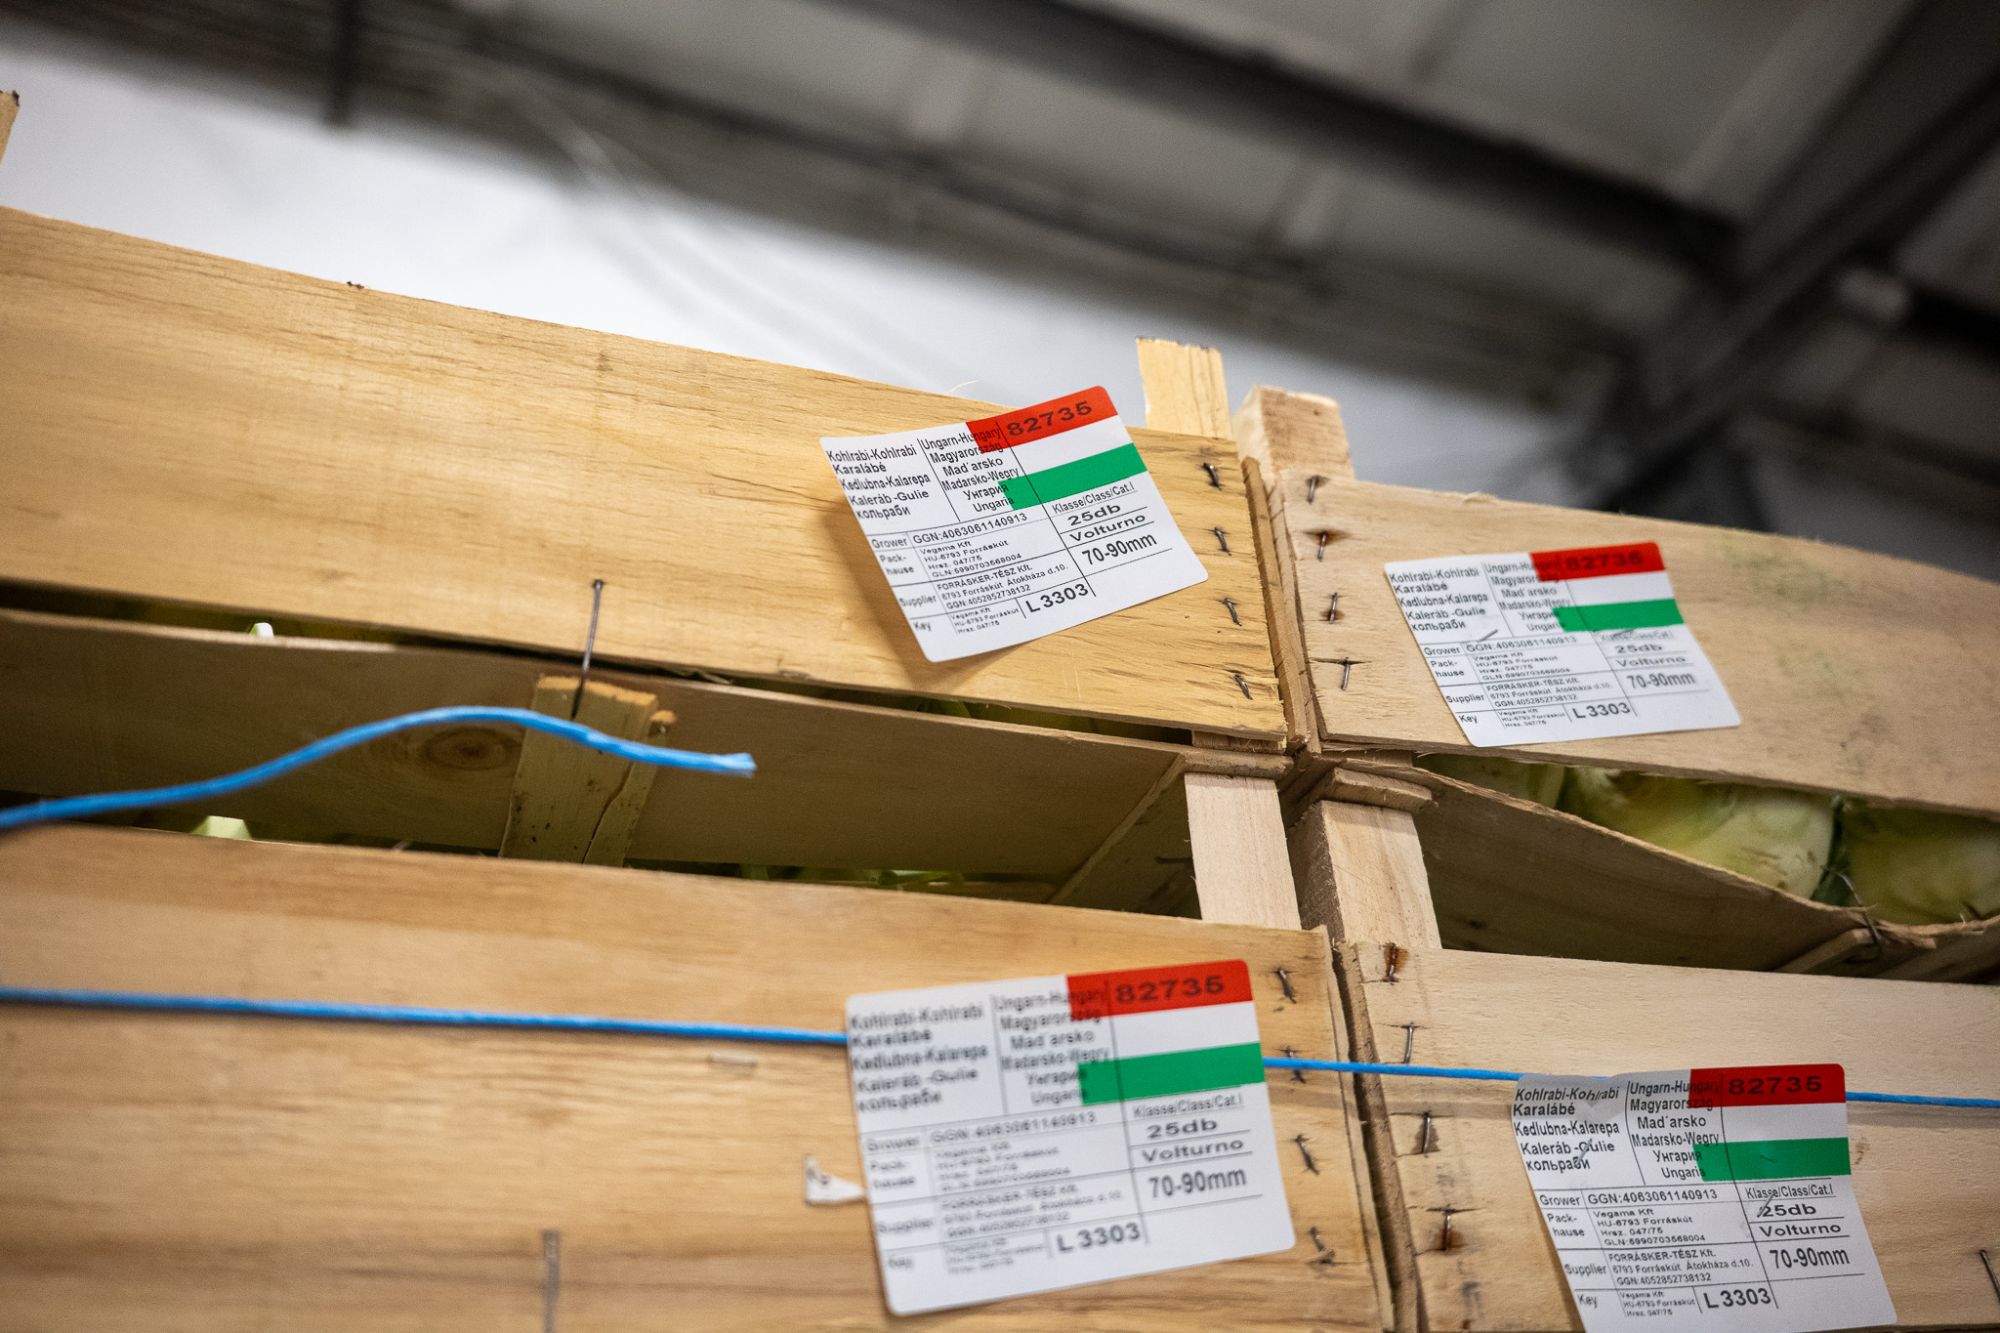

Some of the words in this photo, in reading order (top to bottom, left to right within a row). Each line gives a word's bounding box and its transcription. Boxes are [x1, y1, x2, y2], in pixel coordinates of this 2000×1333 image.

[1008, 401, 1092, 436] 82735
[922, 427, 1000, 450] Ungarn-Hungary
[827, 444, 916, 462] Kohlrabi-Kohlrabi
[930, 443, 1004, 463] Magyarország
[833, 462, 886, 474] Karalábé
[841, 473, 931, 490] Kedlubna-Kalarepa
[942, 468, 1019, 492] Madarsko-Wegry
[848, 493, 892, 506] Kaleráb
[963, 484, 1009, 500] Унгария
[972, 496, 1014, 513] Ungaria
[857, 505, 911, 520] кольраби
[1067, 504, 1120, 526] 25db
[913, 513, 1028, 544] GGN:4063061140913
[1070, 515, 1146, 542] Volturno
[872, 538, 908, 549] Grower
[1082, 534, 1157, 565] 70-90mm
[1486, 556, 1560, 574] Ungarn-Hu
[937, 567, 1016, 590] FORRÁSKER-TÉSZ
[1389, 568, 1479, 583] Kohlrabi-Kohlrabi
[1411, 619, 1466, 632] кольраби
[1424, 647, 1460, 656] Grower
[1615, 644, 1662, 654] 25db
[1435, 668, 1464, 677] hause
[1627, 672, 1696, 688] 70-90mm
[1460, 715, 1478, 724] Key
[1116, 976, 1224, 1002] 82735
[1728, 1076, 1822, 1095] 82735
[1515, 1086, 1619, 1101] Kohlrabi-Kohlrabi
[1513, 1103, 1575, 1116] Karalábé
[1630, 1098, 1712, 1113] Magyarország
[1147, 1118, 1218, 1139] 25db
[1514, 1120, 1620, 1137] Kedlubna-Kalarepa
[1632, 1132, 1719, 1147] Madarsko-Wegry
[1142, 1139, 1243, 1162] Volturno
[1520, 1141, 1570, 1155] Kaleráb
[1526, 1156, 1590, 1173] кольраби
[1653, 1150, 1702, 1164] Унгария
[1661, 1166, 1706, 1180] Ungaria
[1149, 1168, 1247, 1198] 70-90mm
[1540, 1194, 1580, 1206] Grower
[1588, 1188, 1718, 1205] GGN:4063061140913
[1547, 1213, 1576, 1222] Pack-
[1593, 1210, 1635, 1218] Vegama
[1760, 1204, 1816, 1218] 25db
[1597, 1218, 1640, 1227] HU-6793
[1642, 1216, 1693, 1224] Forráskút
[1553, 1228, 1584, 1236] hause
[1760, 1223, 1841, 1237] Volturno
[1609, 1250, 1698, 1262] FORRÁSKER-TÉSZ
[1700, 1249, 1716, 1257] Kft.
[1770, 1247, 1850, 1269] 70-90mm
[1564, 1264, 1607, 1277] Supplier
[1635, 1264, 1680, 1274] Forráskút
[1577, 1295, 1597, 1308] Key
